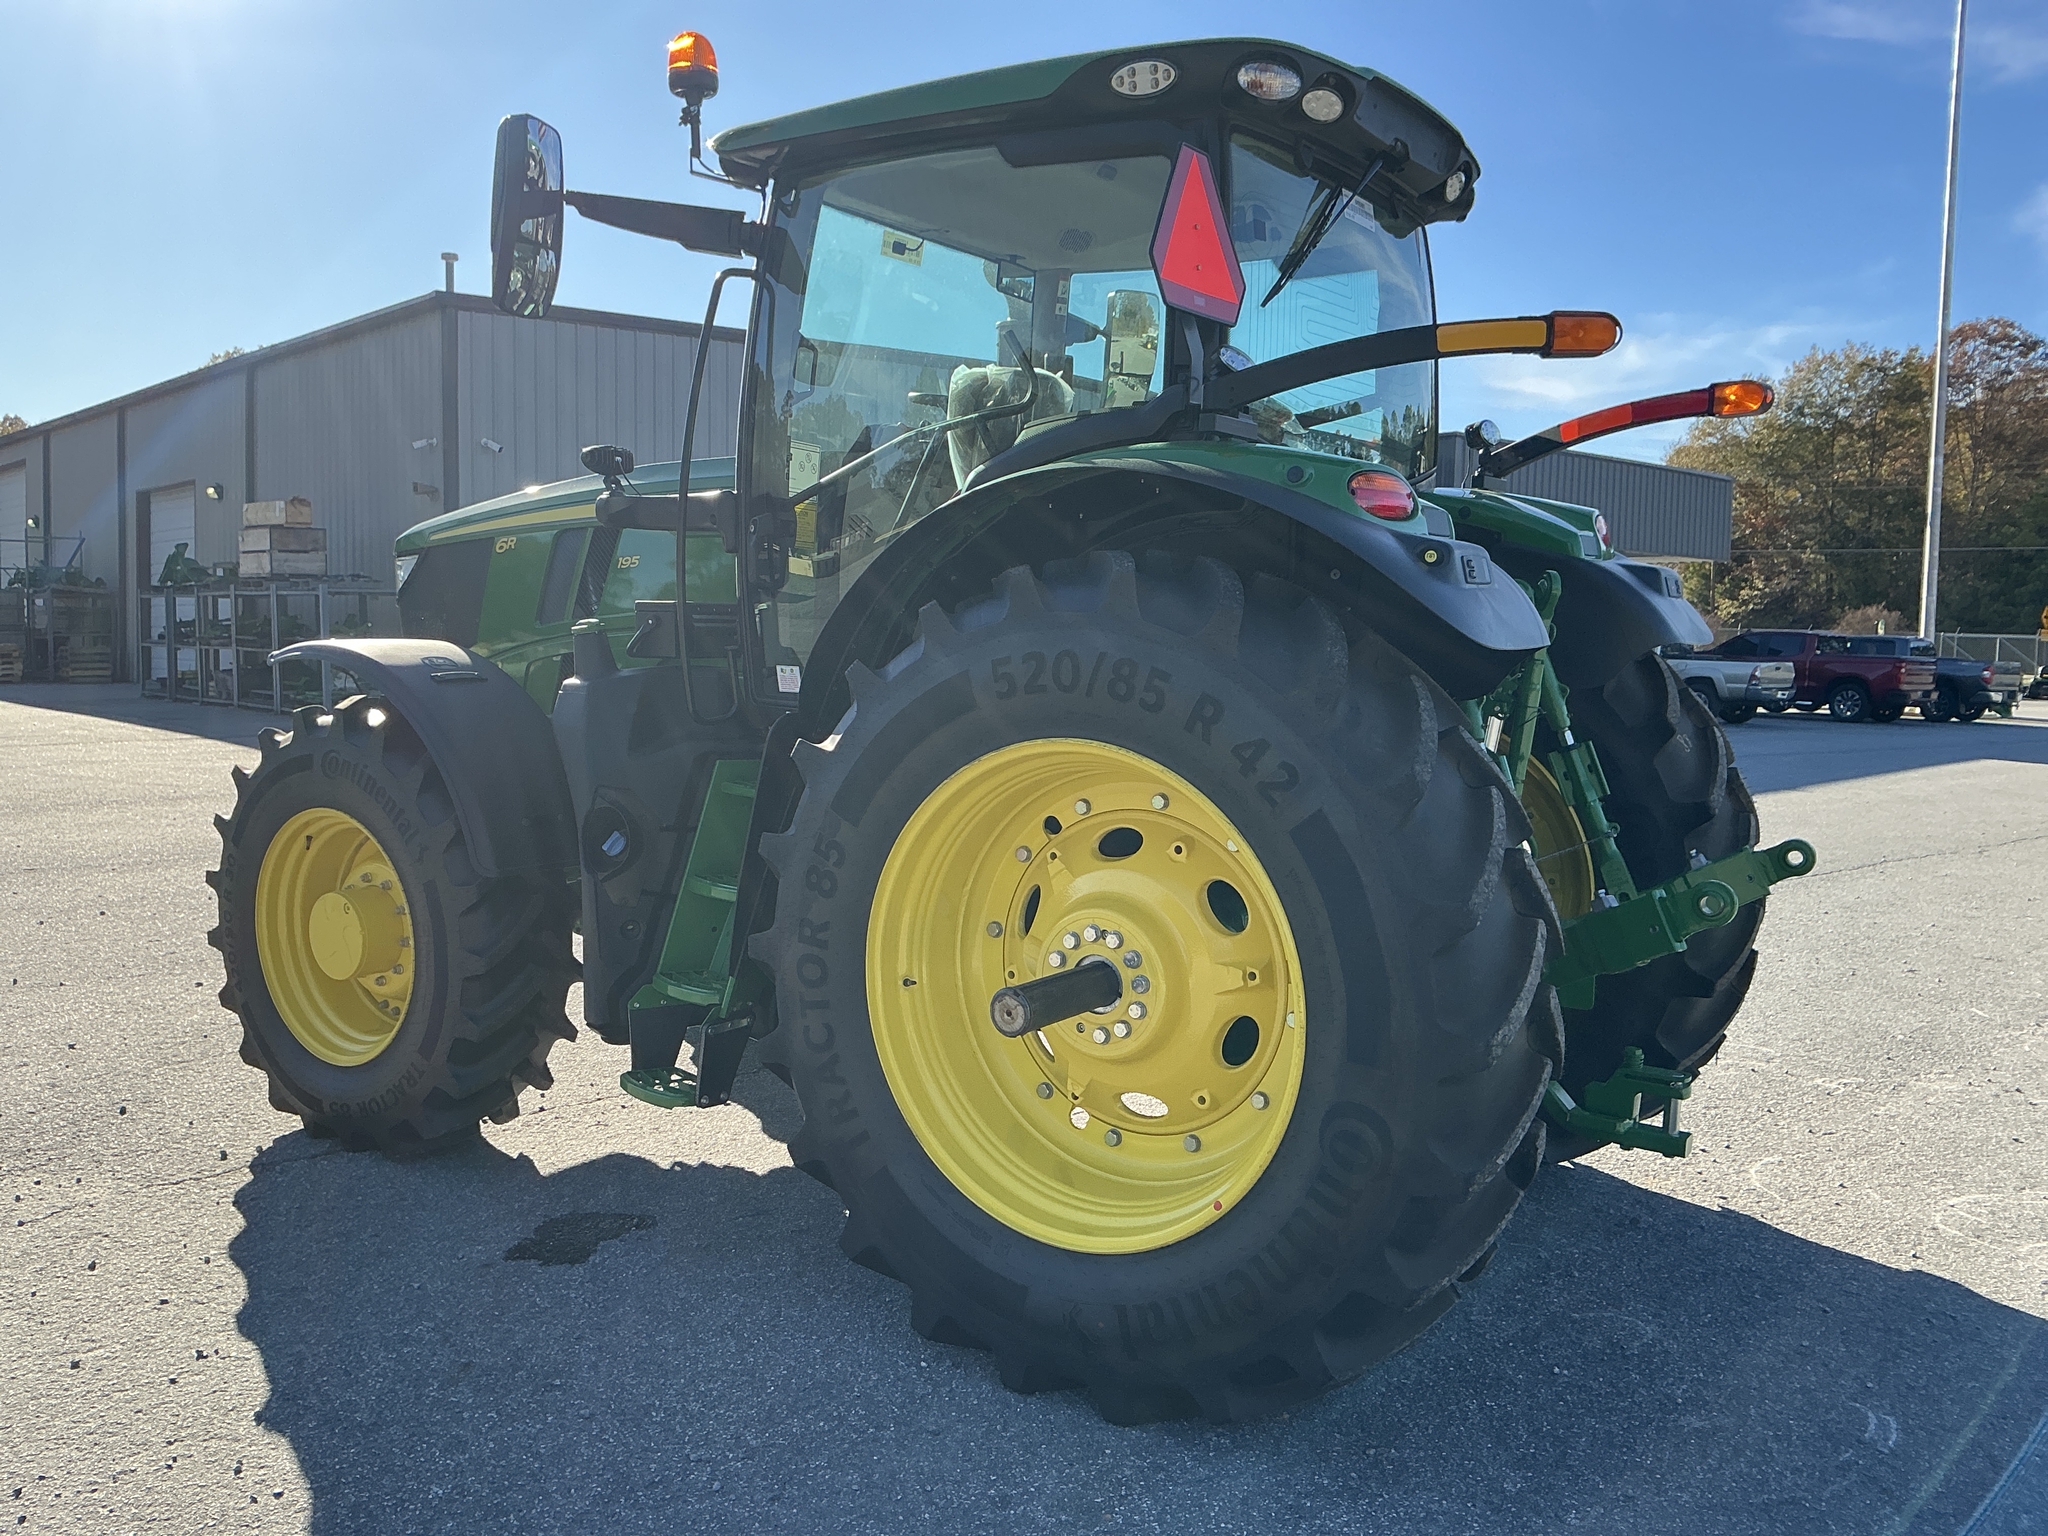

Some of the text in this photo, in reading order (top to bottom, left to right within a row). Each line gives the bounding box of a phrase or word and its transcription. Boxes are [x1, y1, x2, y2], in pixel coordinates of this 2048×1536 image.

[495, 537, 517, 554] 6R
[617, 555, 641, 569] 195
[991, 648, 1300, 809] 520/85 R 42
[321, 749, 420, 847] Continental
[796, 831, 871, 1170] TRACTOR 85
[356, 1062, 427, 1118] TRACTOR
[1114, 1101, 1394, 1362] Continental
